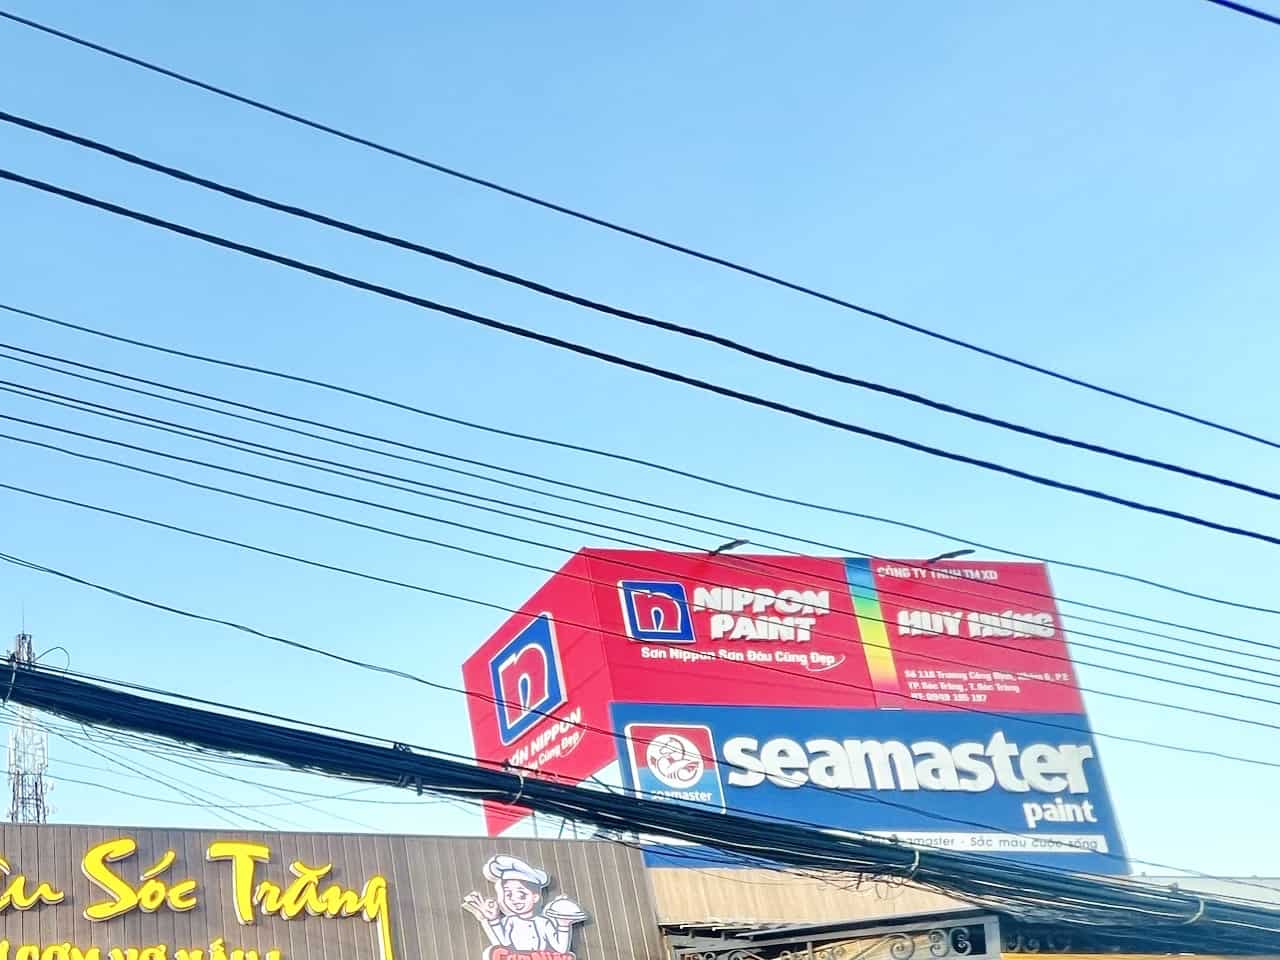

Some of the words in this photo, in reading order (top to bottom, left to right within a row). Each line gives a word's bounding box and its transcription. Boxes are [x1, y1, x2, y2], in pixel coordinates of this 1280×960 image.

[693, 586, 831, 615] NIPPON
[710, 614, 817, 641] PAINT
[897, 611, 964, 637] HUY
[641, 646, 666, 659] Sơn
[530, 706, 582, 756] NIPPON
[721, 730, 1096, 795] seamaster
[1022, 799, 1098, 830] paint
[80, 837, 198, 923] Sóc
